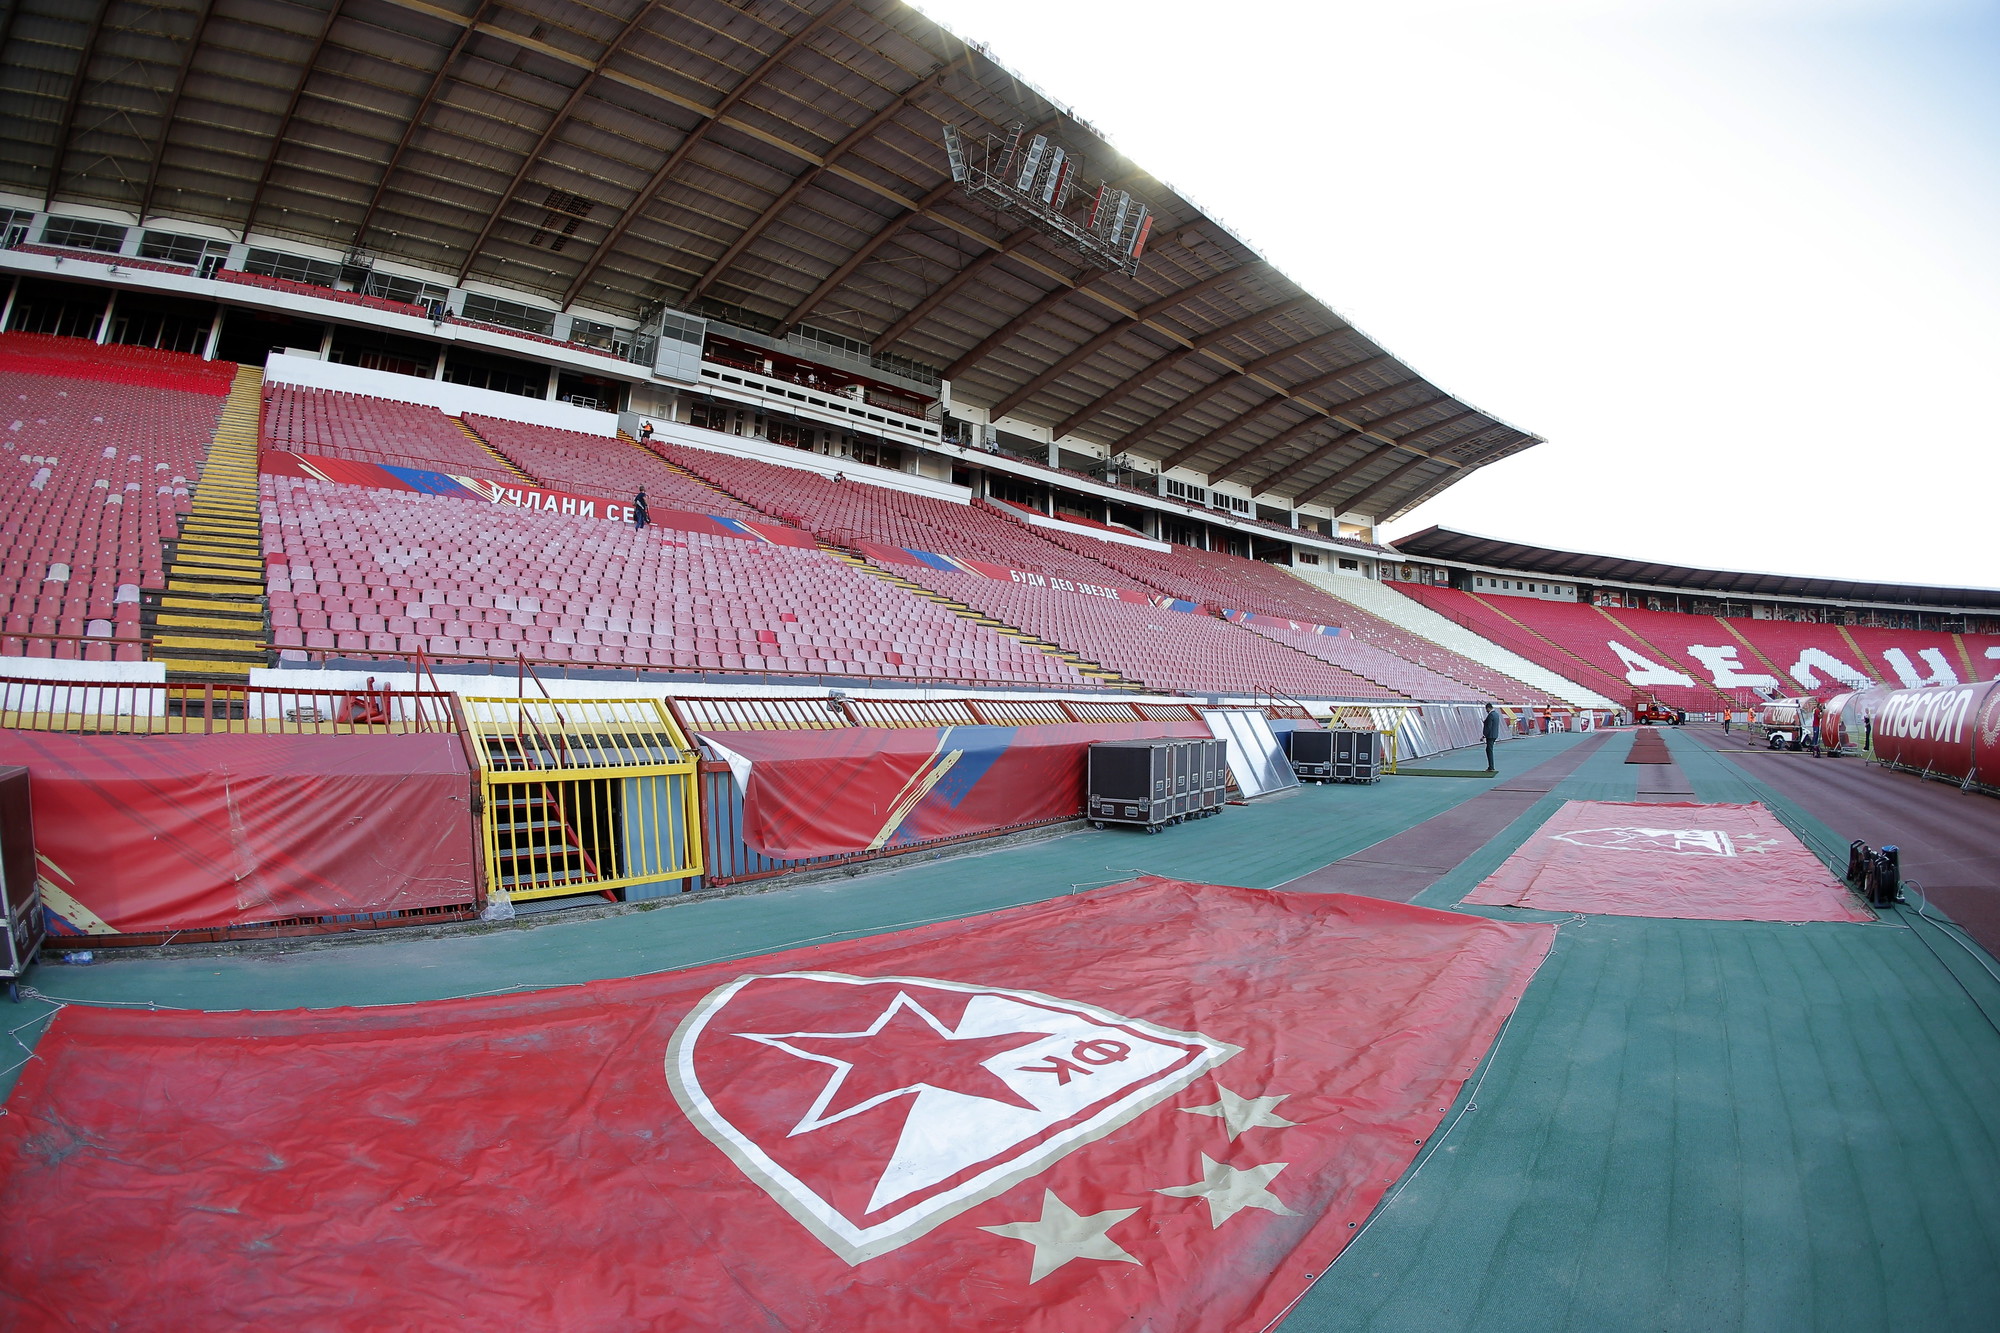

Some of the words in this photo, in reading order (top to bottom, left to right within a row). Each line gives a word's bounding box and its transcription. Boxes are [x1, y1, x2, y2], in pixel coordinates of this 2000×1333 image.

[492, 486, 595, 517] УЧЛАНИ
[1010, 569, 1046, 587] БУДИ
[1051, 577, 1074, 592] ДЕО
[1076, 582, 1120, 600] ЗВЕЗДЕ
[1879, 689, 1974, 744] macron
[1014, 1038, 1132, 1087] ФК
